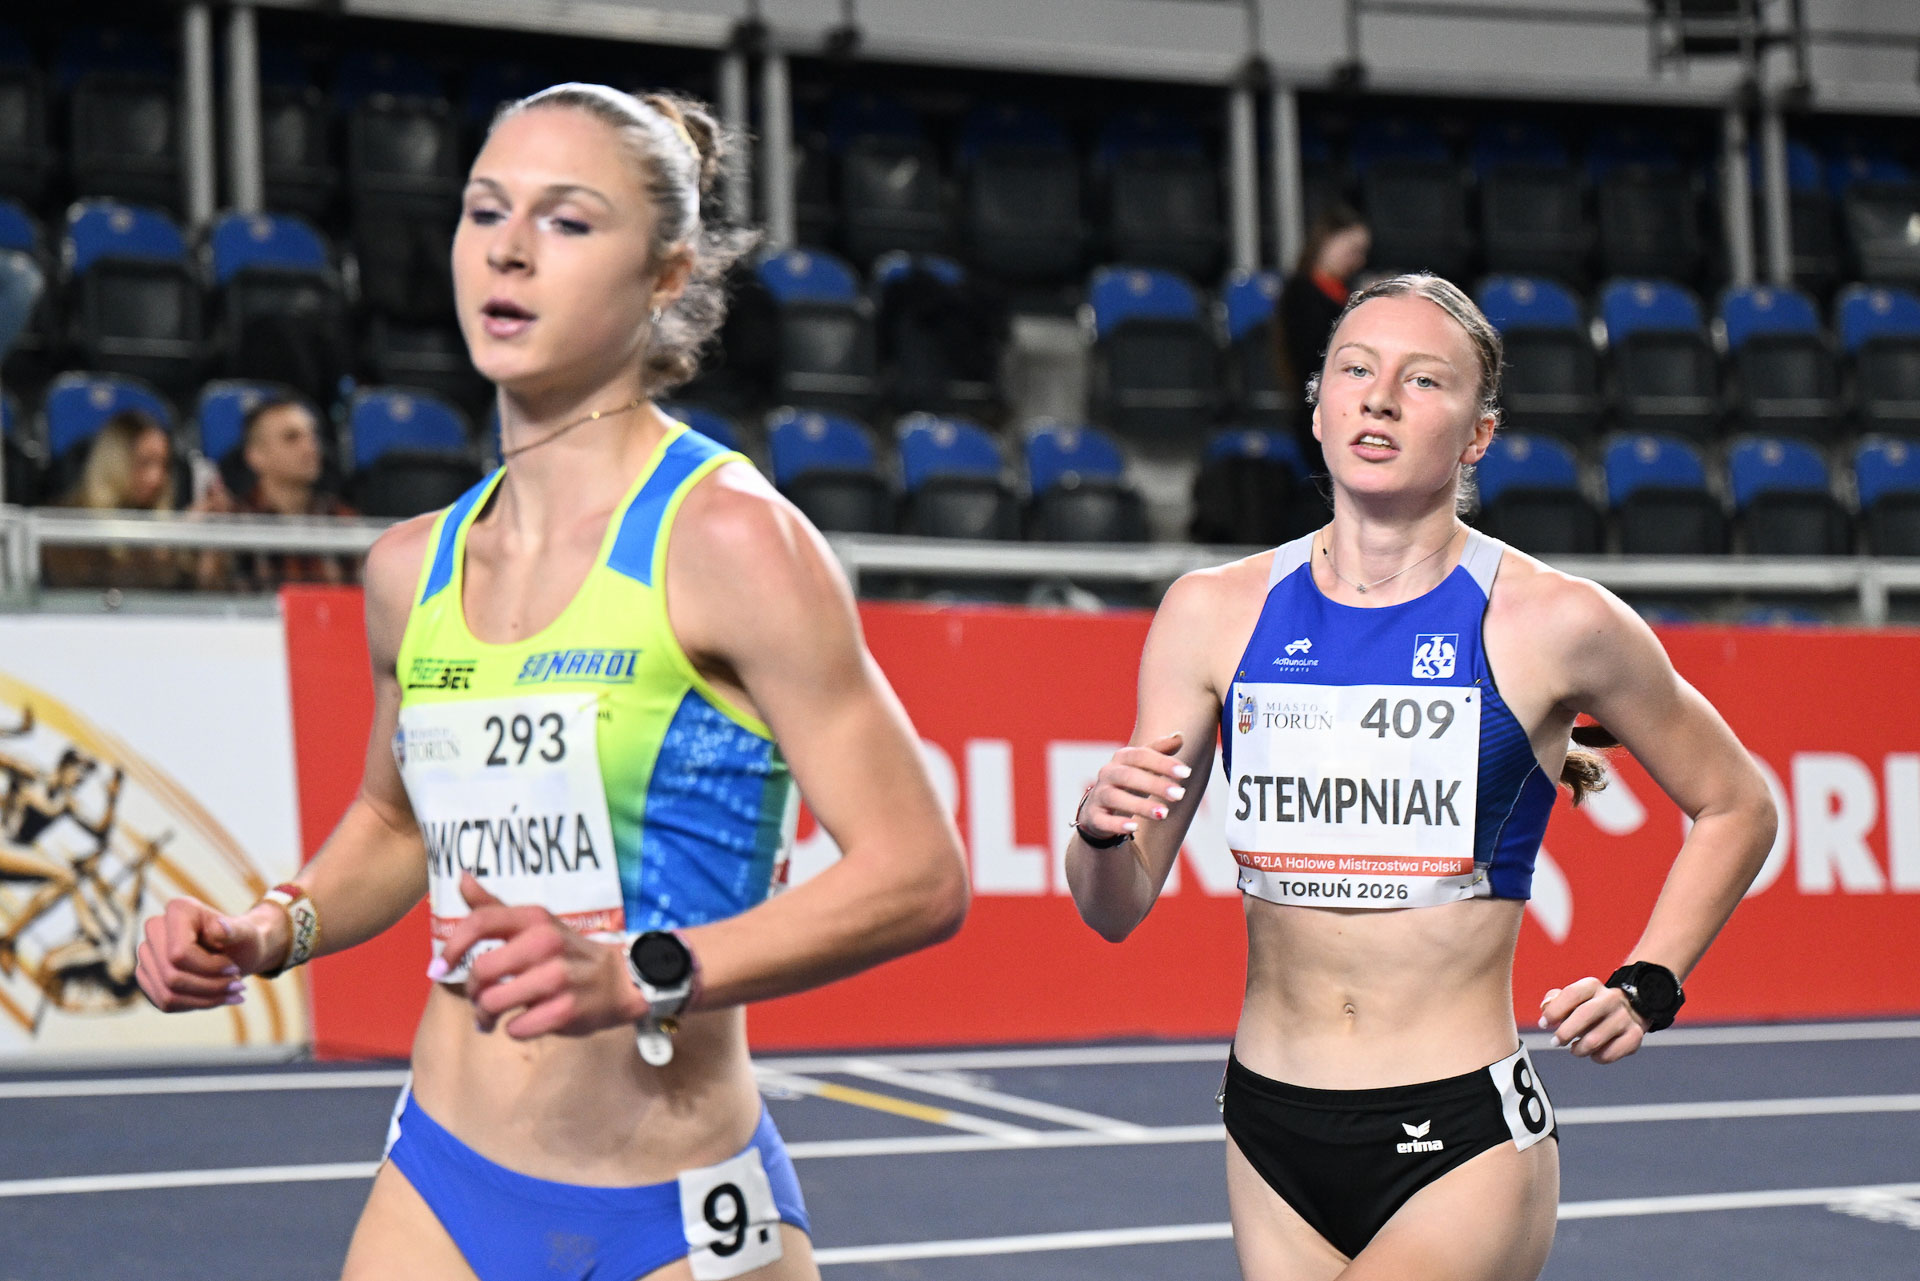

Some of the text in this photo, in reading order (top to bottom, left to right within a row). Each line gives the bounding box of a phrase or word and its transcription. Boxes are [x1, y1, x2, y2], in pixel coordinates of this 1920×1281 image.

[1262, 711, 1333, 730] TORUŃ
[1266, 702, 1318, 712] MIASTO
[1360, 698, 1455, 739] 409
[486, 712, 566, 766] 293
[1235, 774, 1462, 827] STEMPNIAK
[1253, 855, 1283, 868] PZLA
[1286, 857, 1335, 870] Halowe
[1338, 858, 1419, 872] Mistrzostwa
[1422, 860, 1462, 873] Polski
[1279, 878, 1409, 900] TORUŃ 2026
[1513, 1057, 1546, 1135] 8
[1396, 1139, 1444, 1154] erima
[703, 1182, 769, 1257] 9.
